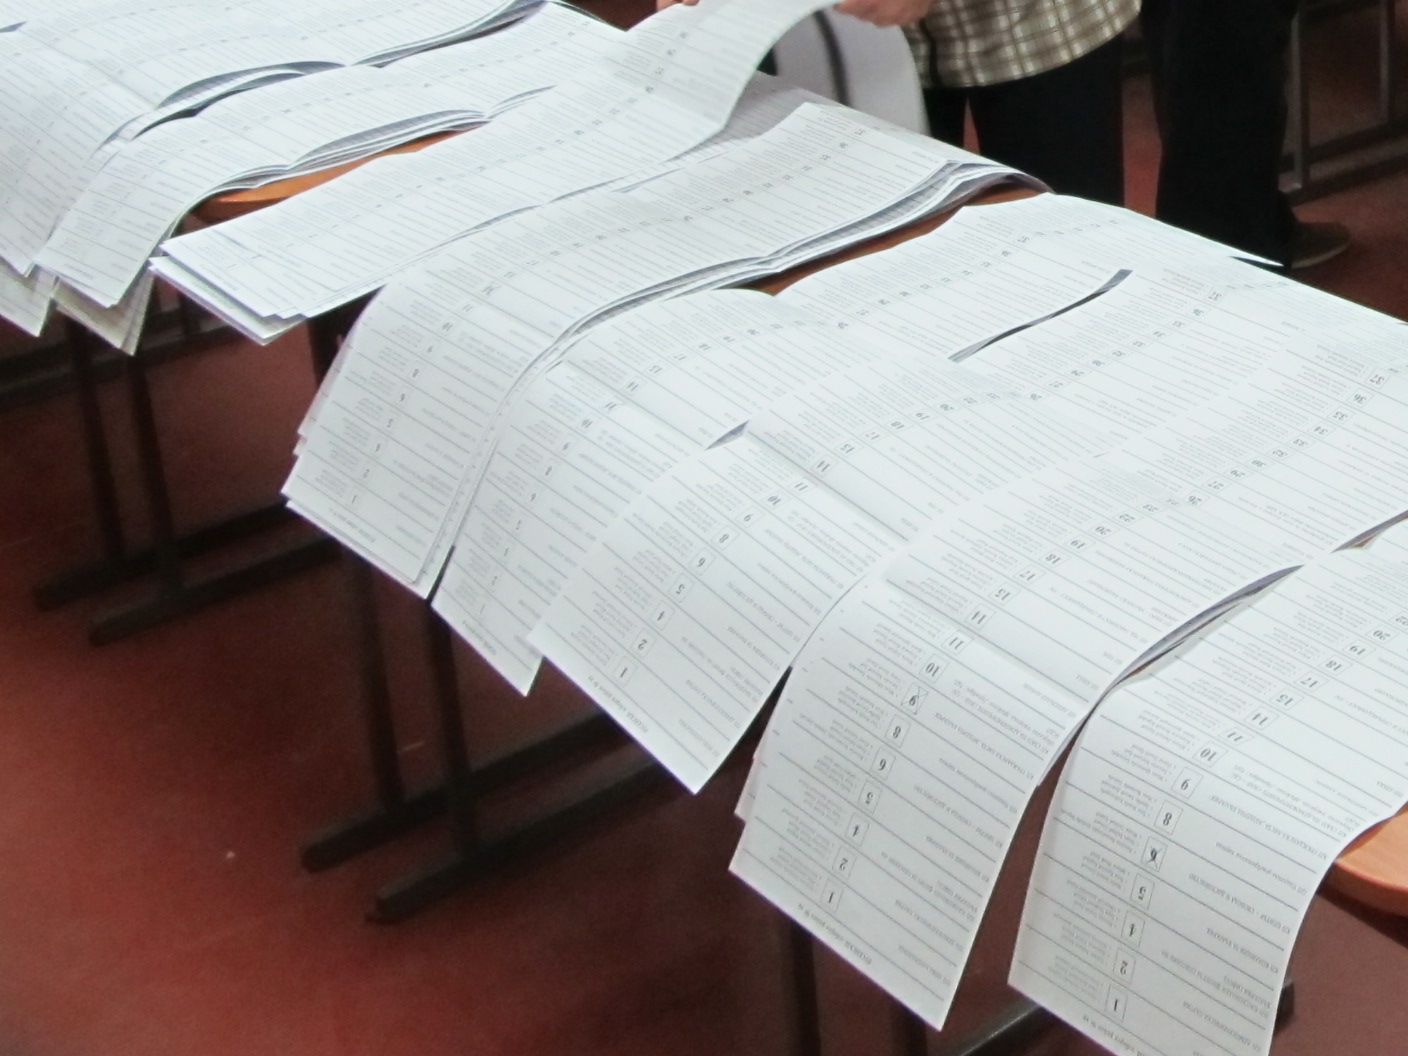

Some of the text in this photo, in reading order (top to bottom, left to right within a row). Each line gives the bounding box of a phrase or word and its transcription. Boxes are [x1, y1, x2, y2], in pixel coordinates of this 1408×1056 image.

[1369, 374, 1385, 385] 37
[1354, 394, 1367, 404] 36
[1333, 411, 1348, 421] 35
[1314, 426, 1328, 435] 34
[1293, 439, 1308, 447] 33
[1272, 449, 1288, 457] 32
[1251, 460, 1267, 468] 30
[1230, 470, 1245, 478] 29
[1207, 481, 1224, 490] 27
[1188, 496, 1202, 505] 26
[1142, 504, 1158, 512] 23
[1119, 513, 1135, 522] 22
[1095, 526, 1111, 535] 20
[1070, 540, 1086, 549] 19
[1045, 554, 1061, 564] 18
[1019, 571, 1035, 581] 17
[995, 588, 1010, 601] 15
[971, 611, 986, 624] 14
[1373, 630, 1391, 640] 20
[949, 637, 964, 650] 11
[1349, 646, 1366, 655] 19
[925, 663, 940, 677] 10
[1326, 660, 1342, 671] 18
[1300, 677, 1318, 688] 17
[1276, 694, 1293, 706] 15
[1252, 713, 1268, 725] 14
[893, 726, 901, 739] 8
[1227, 732, 1243, 742] 11
[1200, 749, 1217, 761] 10
[879, 759, 886, 771] 6
[1181, 779, 1189, 790] 9
[865, 792, 873, 805] 5
[1163, 812, 1172, 826] 8
[839, 858, 848, 870] 2
[828, 892, 834, 903] 1
[1138, 886, 1146, 901] 5
[1120, 960, 1128, 975] 2
[1114, 999, 1118, 1011] 1
